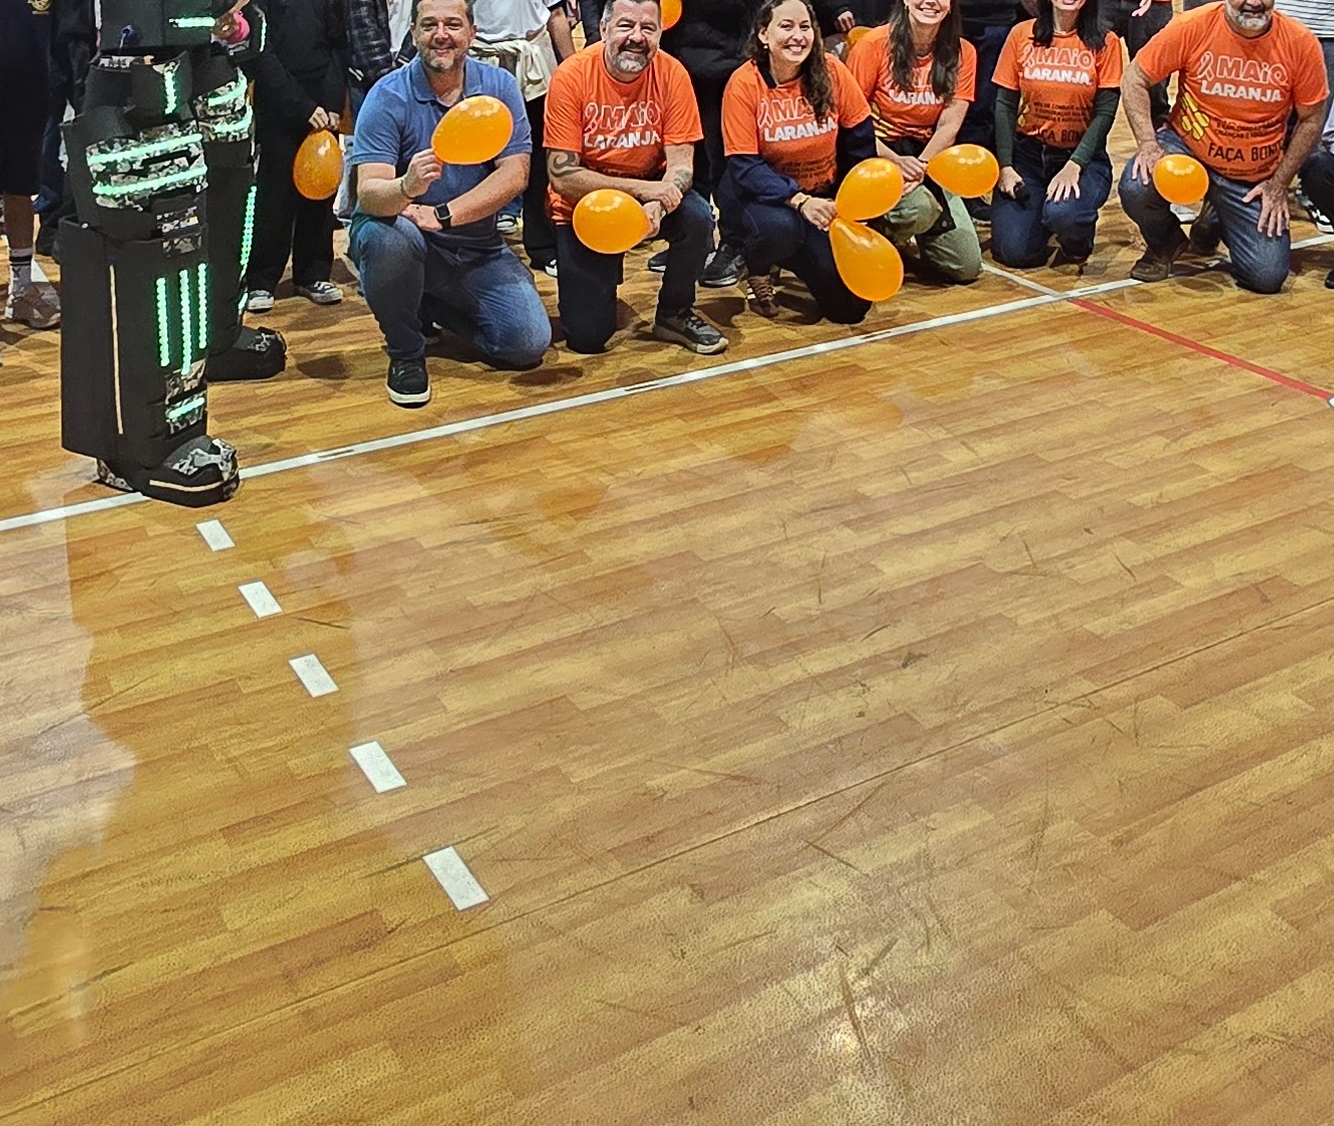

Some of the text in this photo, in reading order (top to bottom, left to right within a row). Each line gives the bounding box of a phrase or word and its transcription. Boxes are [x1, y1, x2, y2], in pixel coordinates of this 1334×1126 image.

[1024, 66, 1092, 85] LARANJA
[1201, 80, 1284, 102] LARANJA
[764, 117, 837, 142] LARANJA
[584, 130, 662, 150] LARANJA
[1208, 142, 1245, 162] FAÇA
